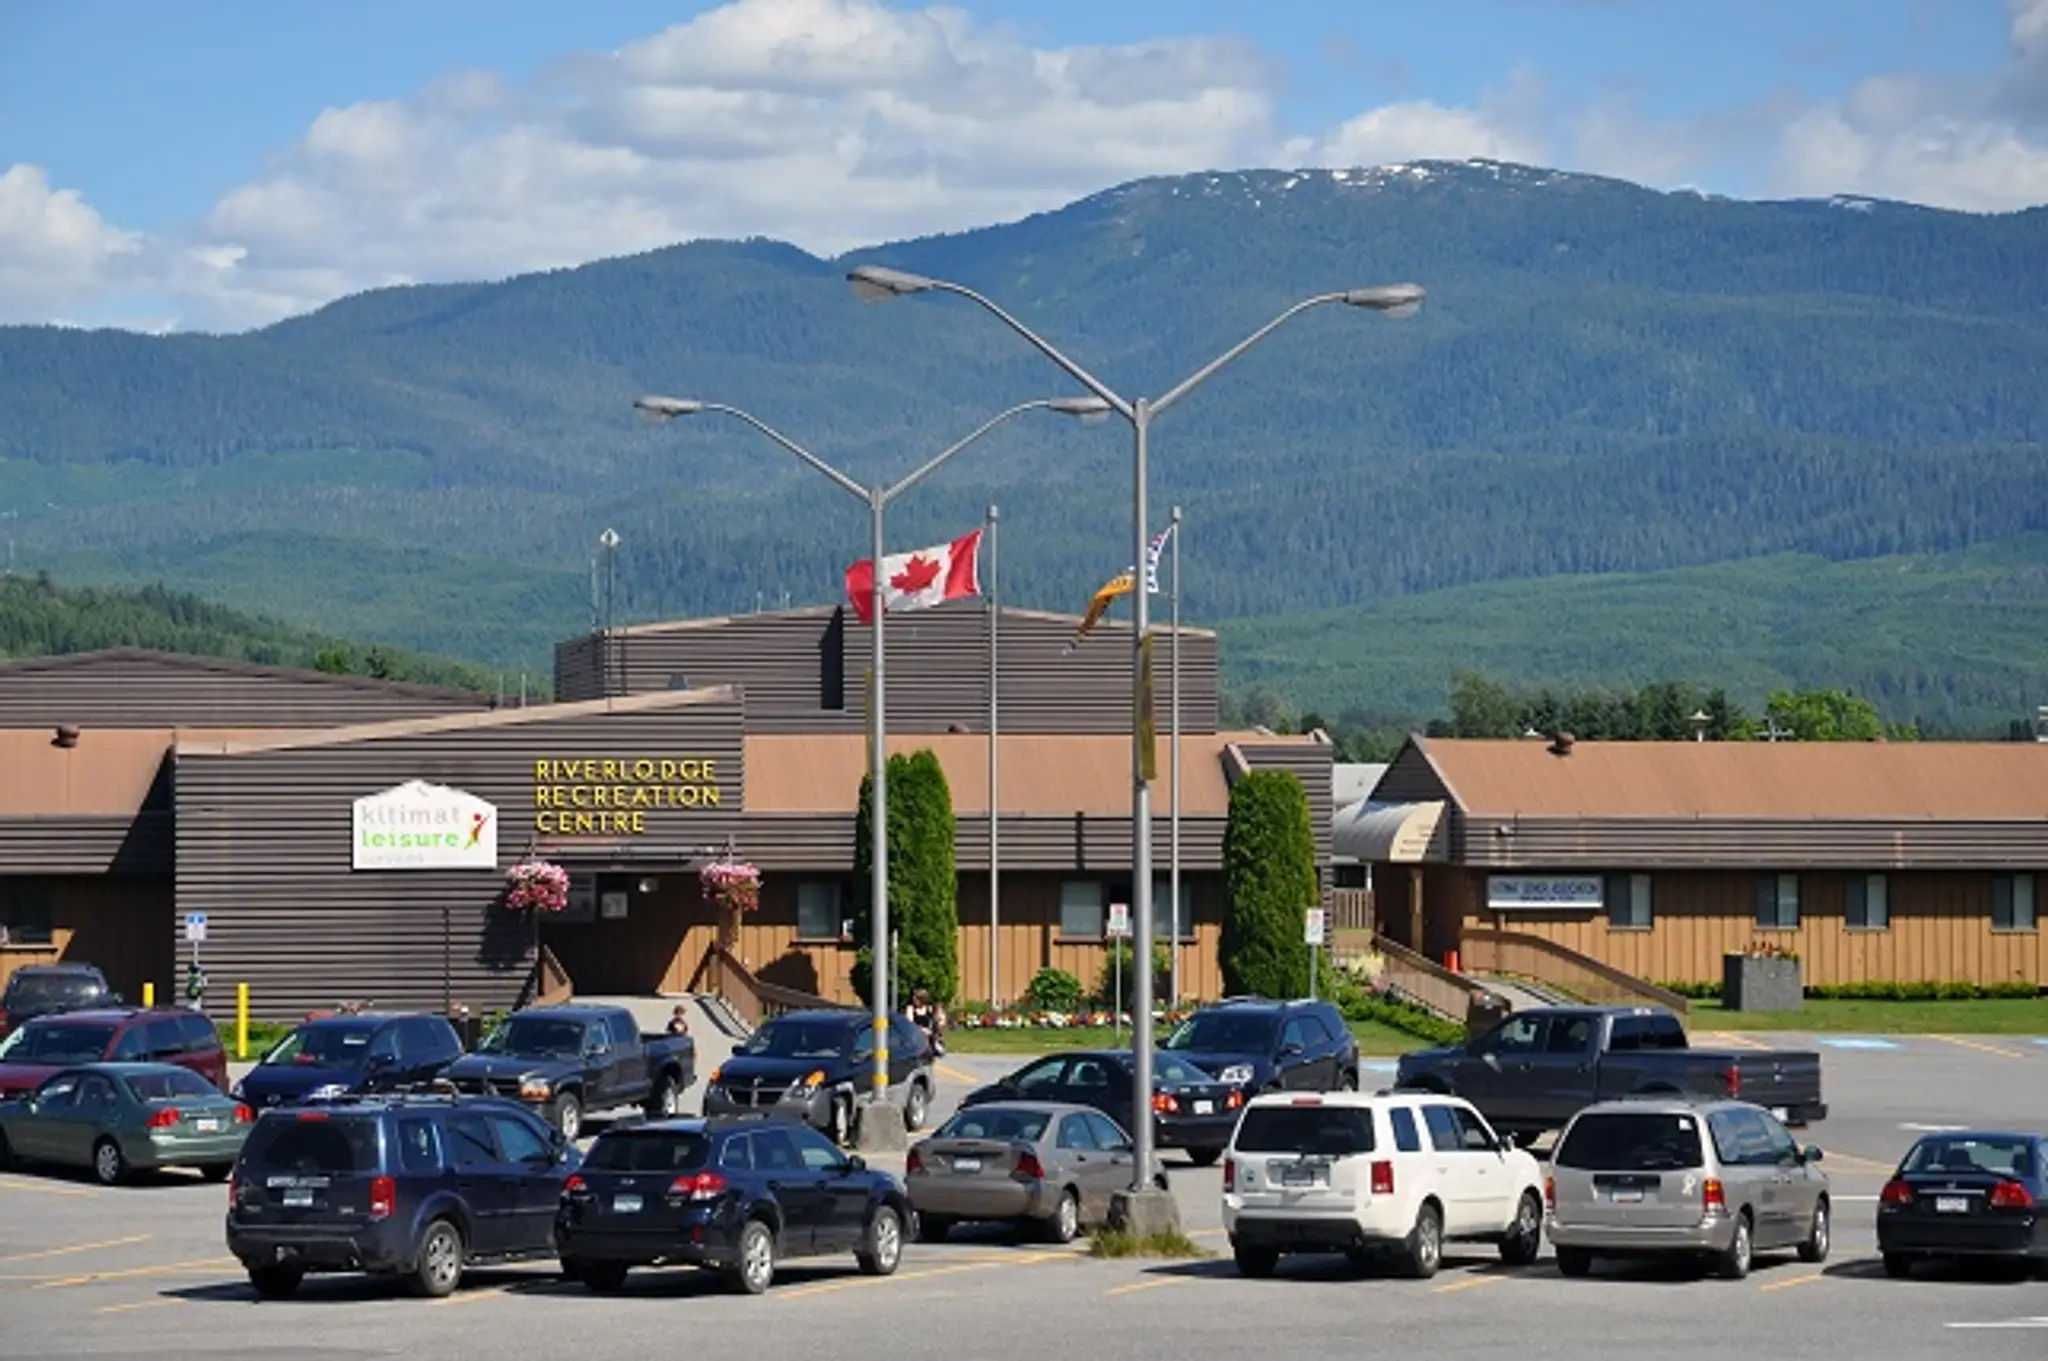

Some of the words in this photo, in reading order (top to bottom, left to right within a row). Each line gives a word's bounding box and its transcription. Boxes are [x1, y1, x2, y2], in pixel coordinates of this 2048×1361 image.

[535, 759, 716, 782] RIVERLODGE
[535, 785, 722, 807] RECREATION
[360, 804, 461, 827] kitimat
[535, 810, 646, 833] CENTRE
[360, 828, 461, 848] leisure
